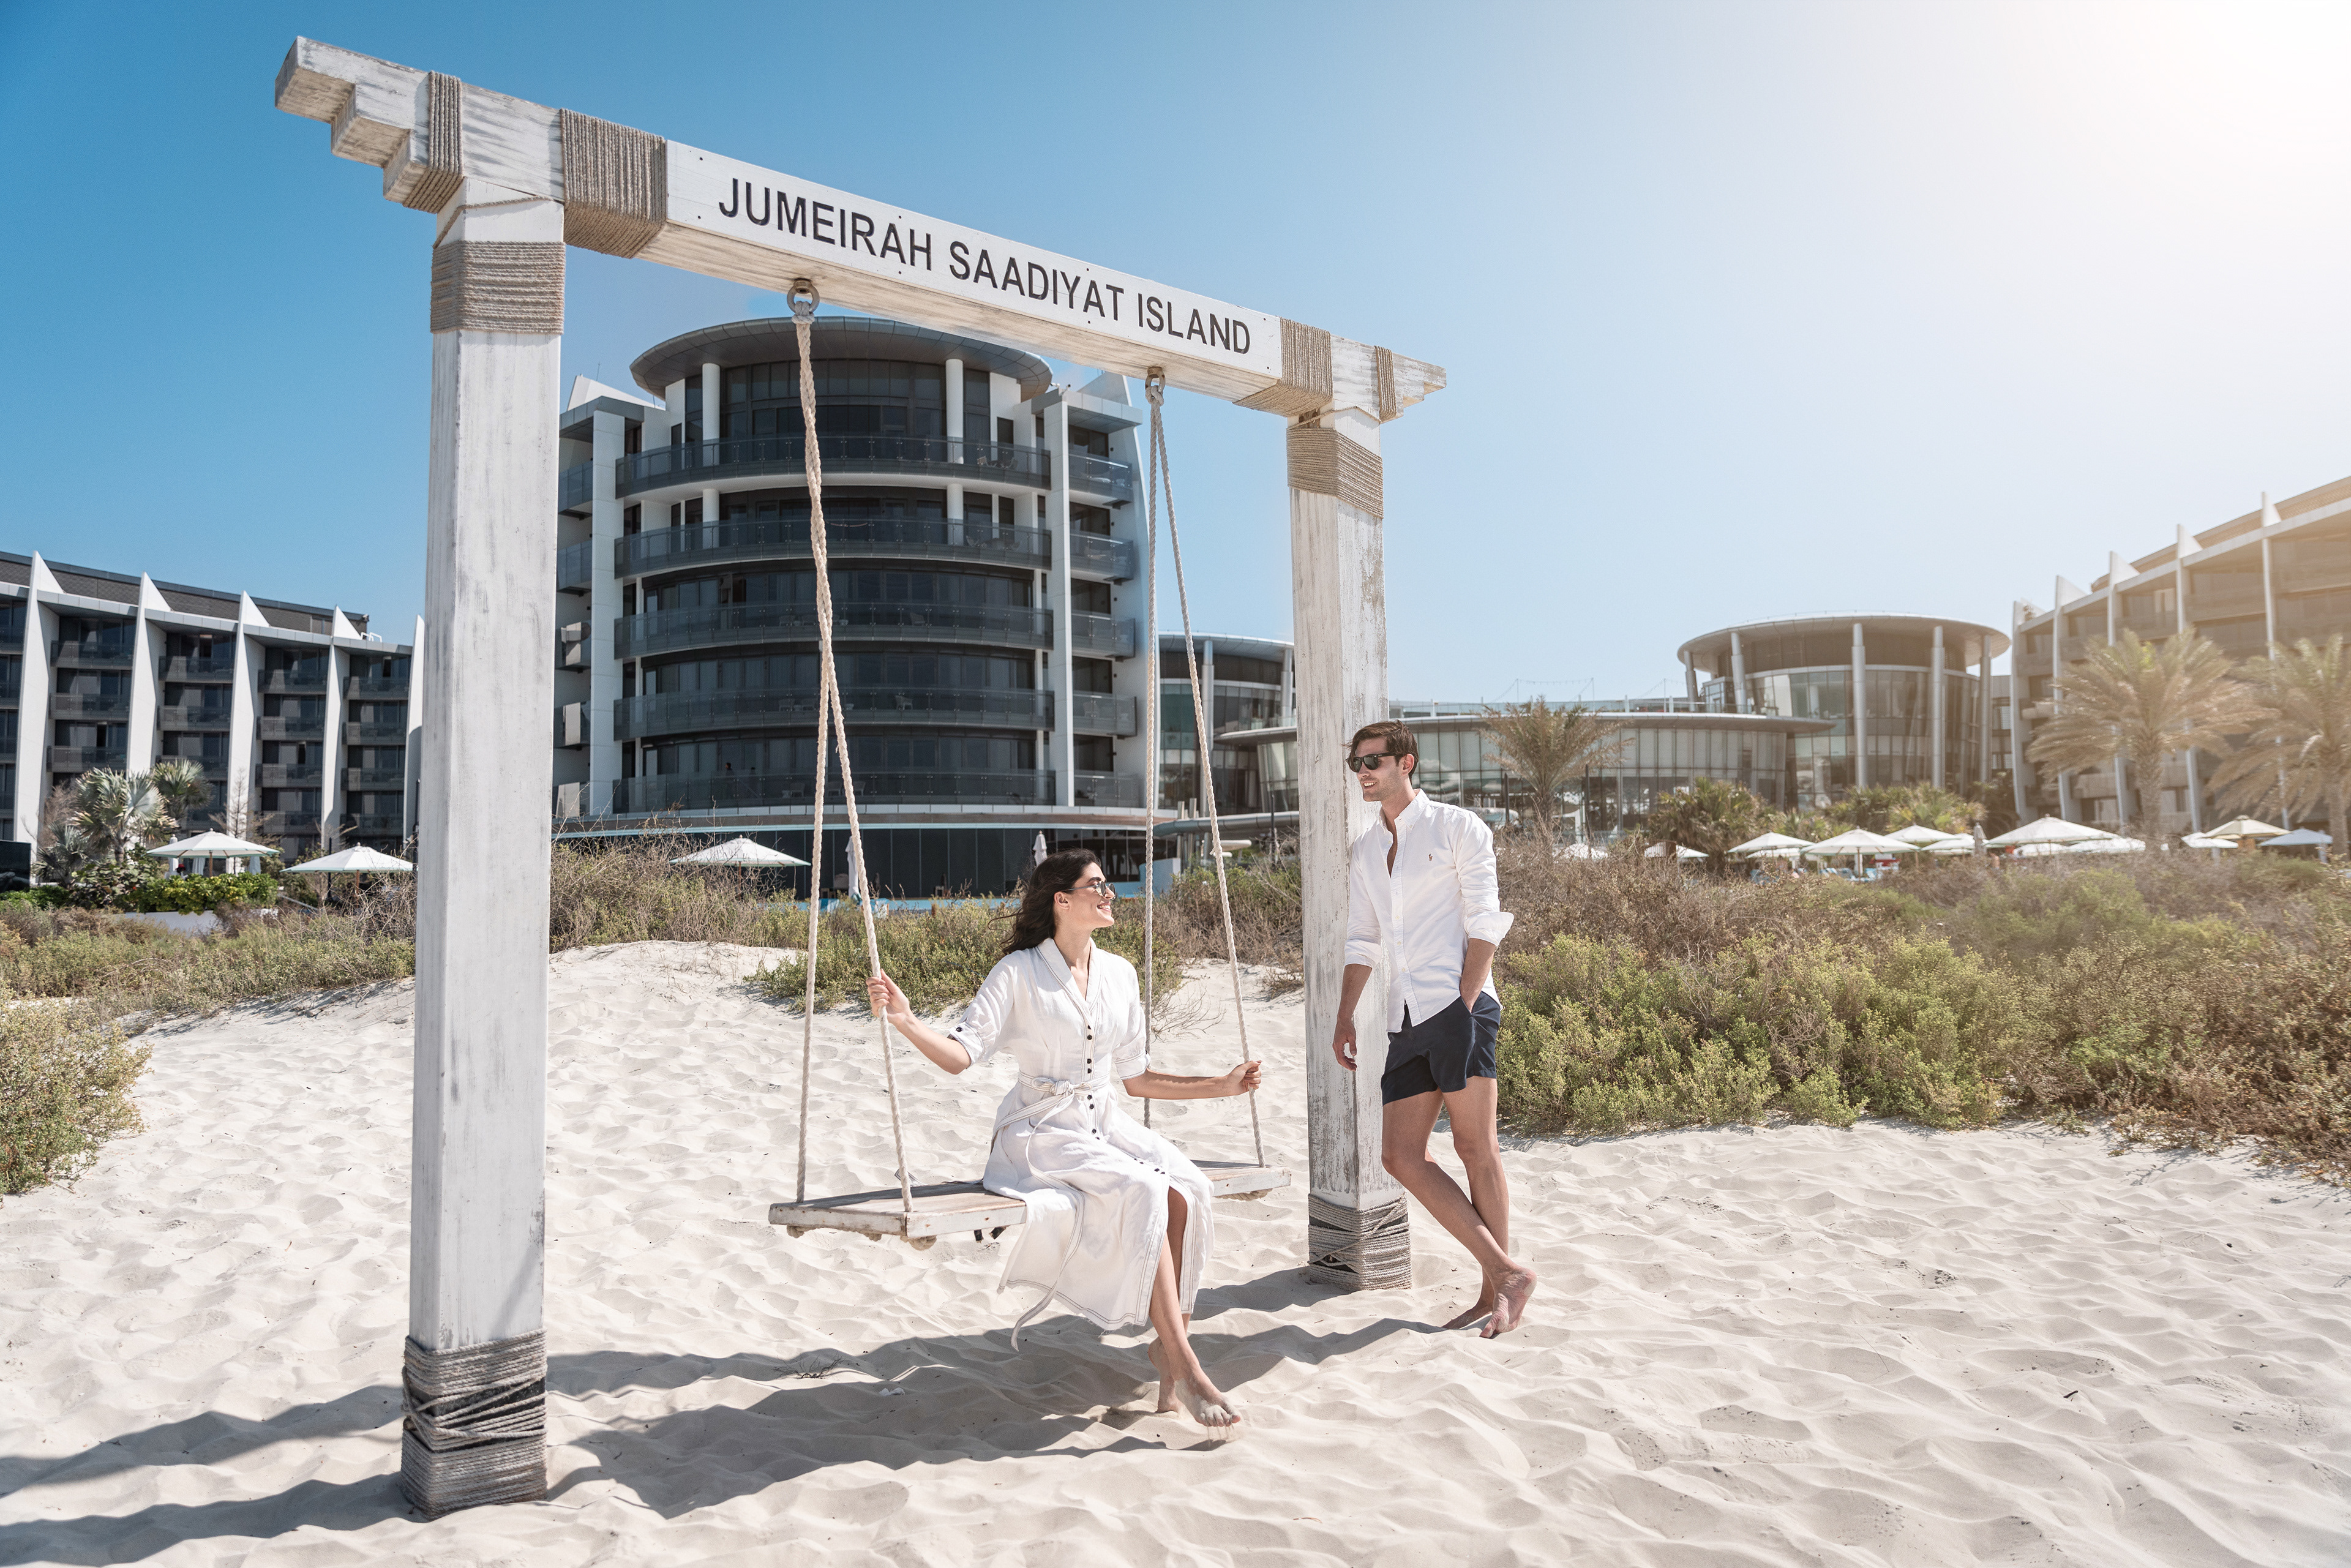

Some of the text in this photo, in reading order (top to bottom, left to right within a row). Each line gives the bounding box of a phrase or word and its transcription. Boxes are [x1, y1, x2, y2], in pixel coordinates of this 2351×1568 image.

[718, 178, 1250, 354] JUMEIRAH SAADIYAT ISLAND
